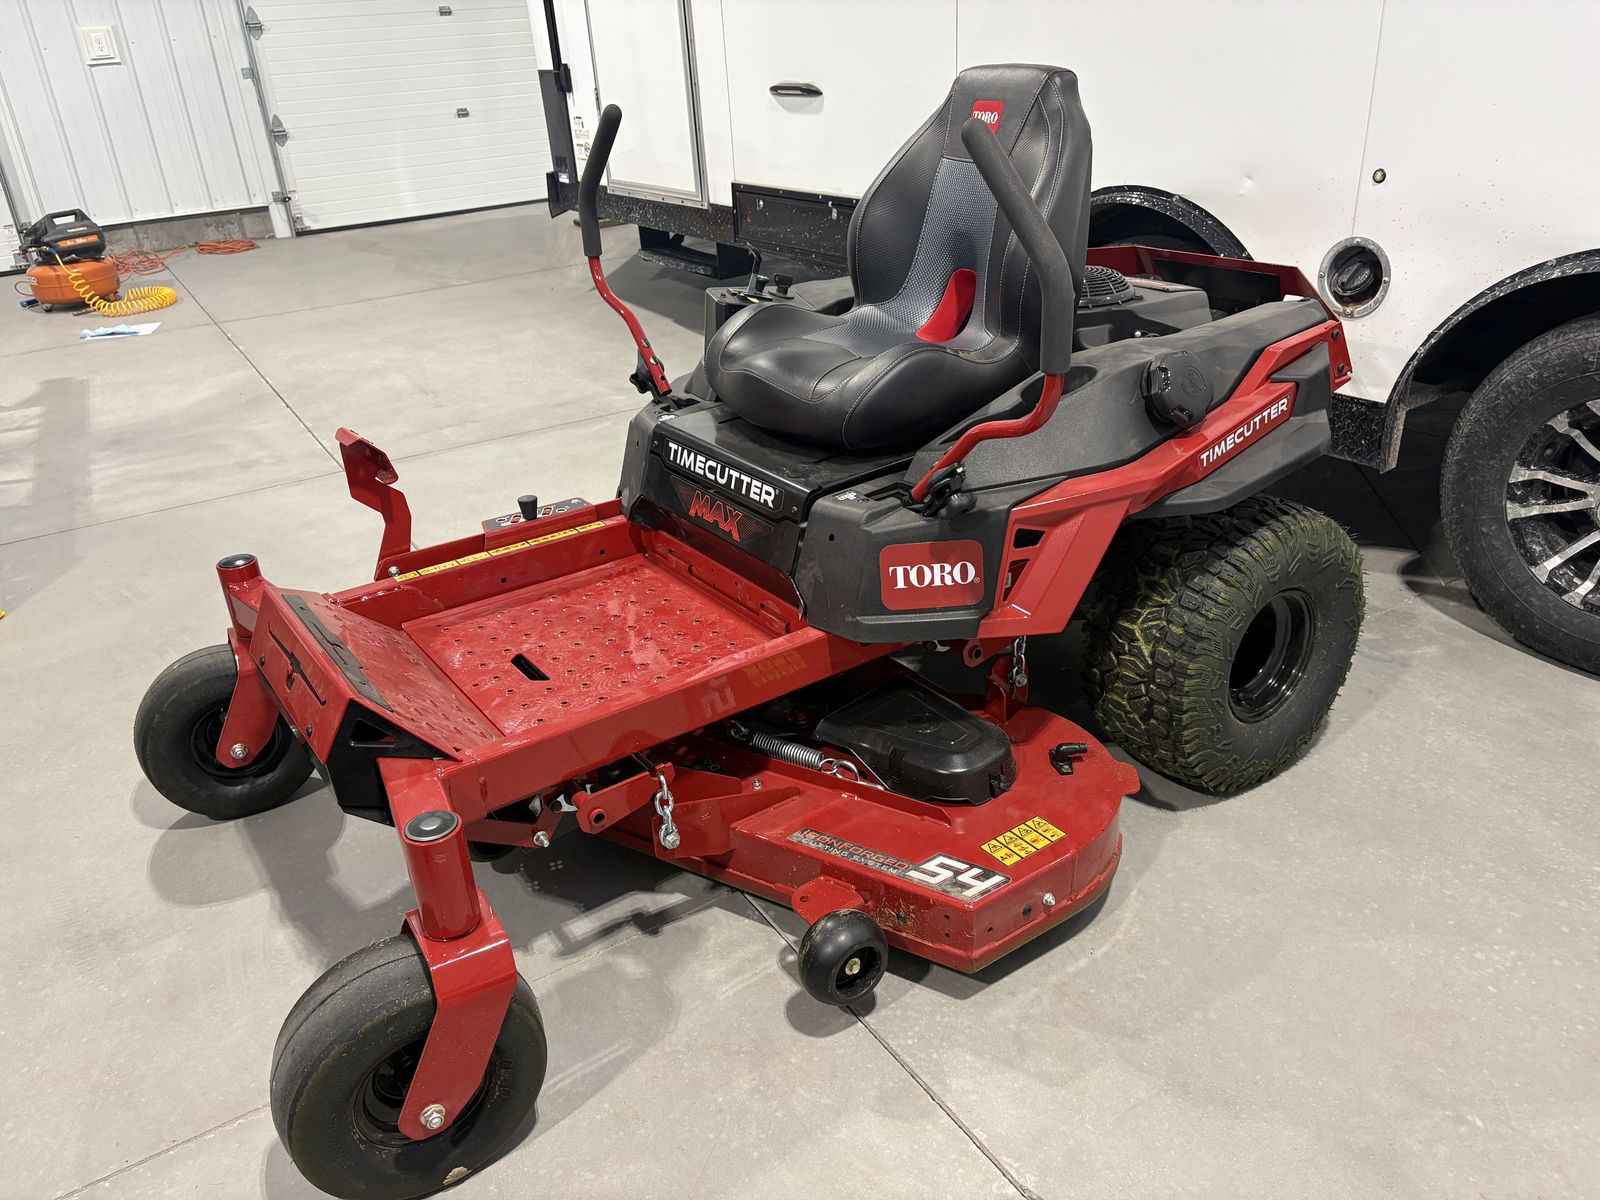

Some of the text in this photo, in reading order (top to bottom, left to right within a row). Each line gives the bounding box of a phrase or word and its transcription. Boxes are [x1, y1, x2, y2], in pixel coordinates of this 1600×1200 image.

[972, 111, 999, 124] TORO
[1200, 398, 1288, 467] TIMECUTTER
[668, 442, 775, 508] TIMECUTTER
[689, 490, 743, 542] MAX
[889, 561, 976, 589] TORO
[801, 829, 910, 870] IRONFORGED
[802, 838, 898, 874] CUTTING SYSTEM
[905, 855, 1006, 897] 54
